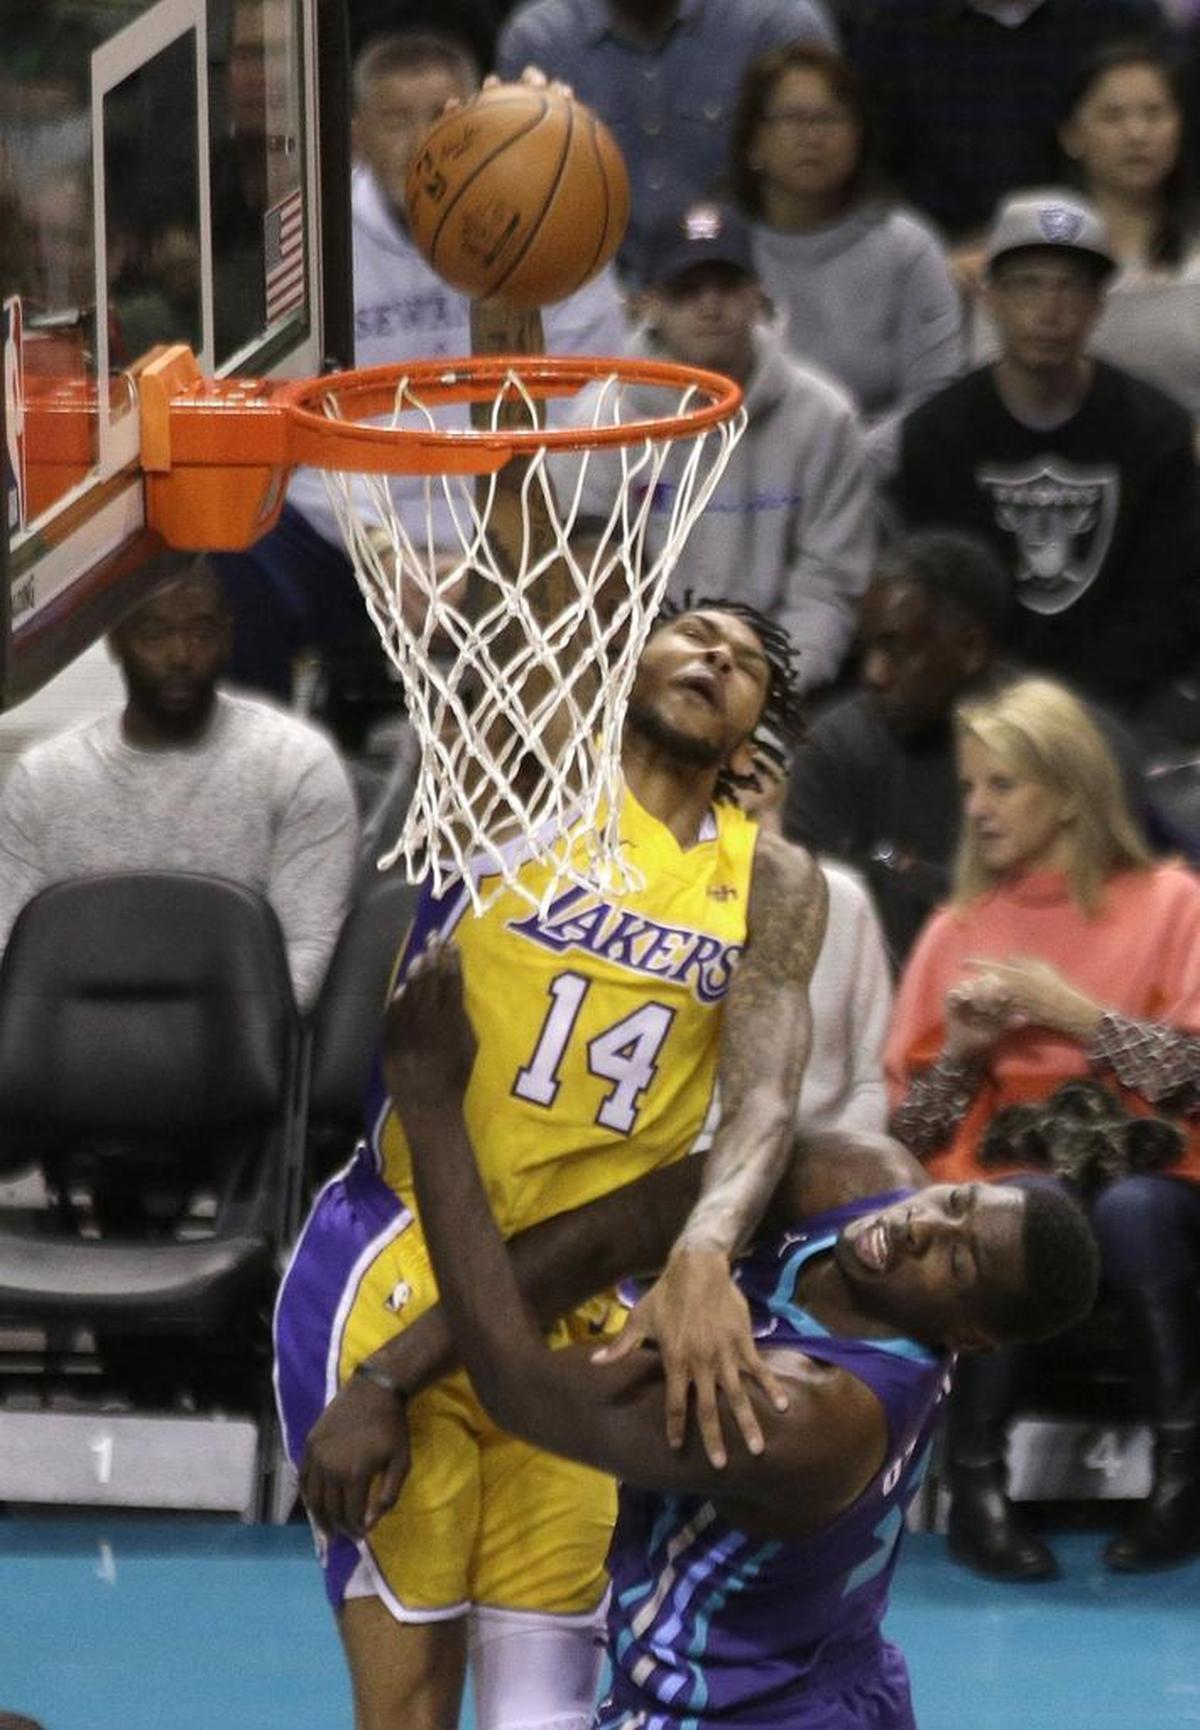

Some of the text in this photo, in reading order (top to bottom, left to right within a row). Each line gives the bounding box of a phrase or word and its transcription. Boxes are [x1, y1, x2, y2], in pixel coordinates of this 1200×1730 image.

[507, 884, 743, 1003] LAKERS
[511, 970, 677, 1135] 14
[91, 1436, 113, 1483] 1
[1085, 1431, 1122, 1478] 4
